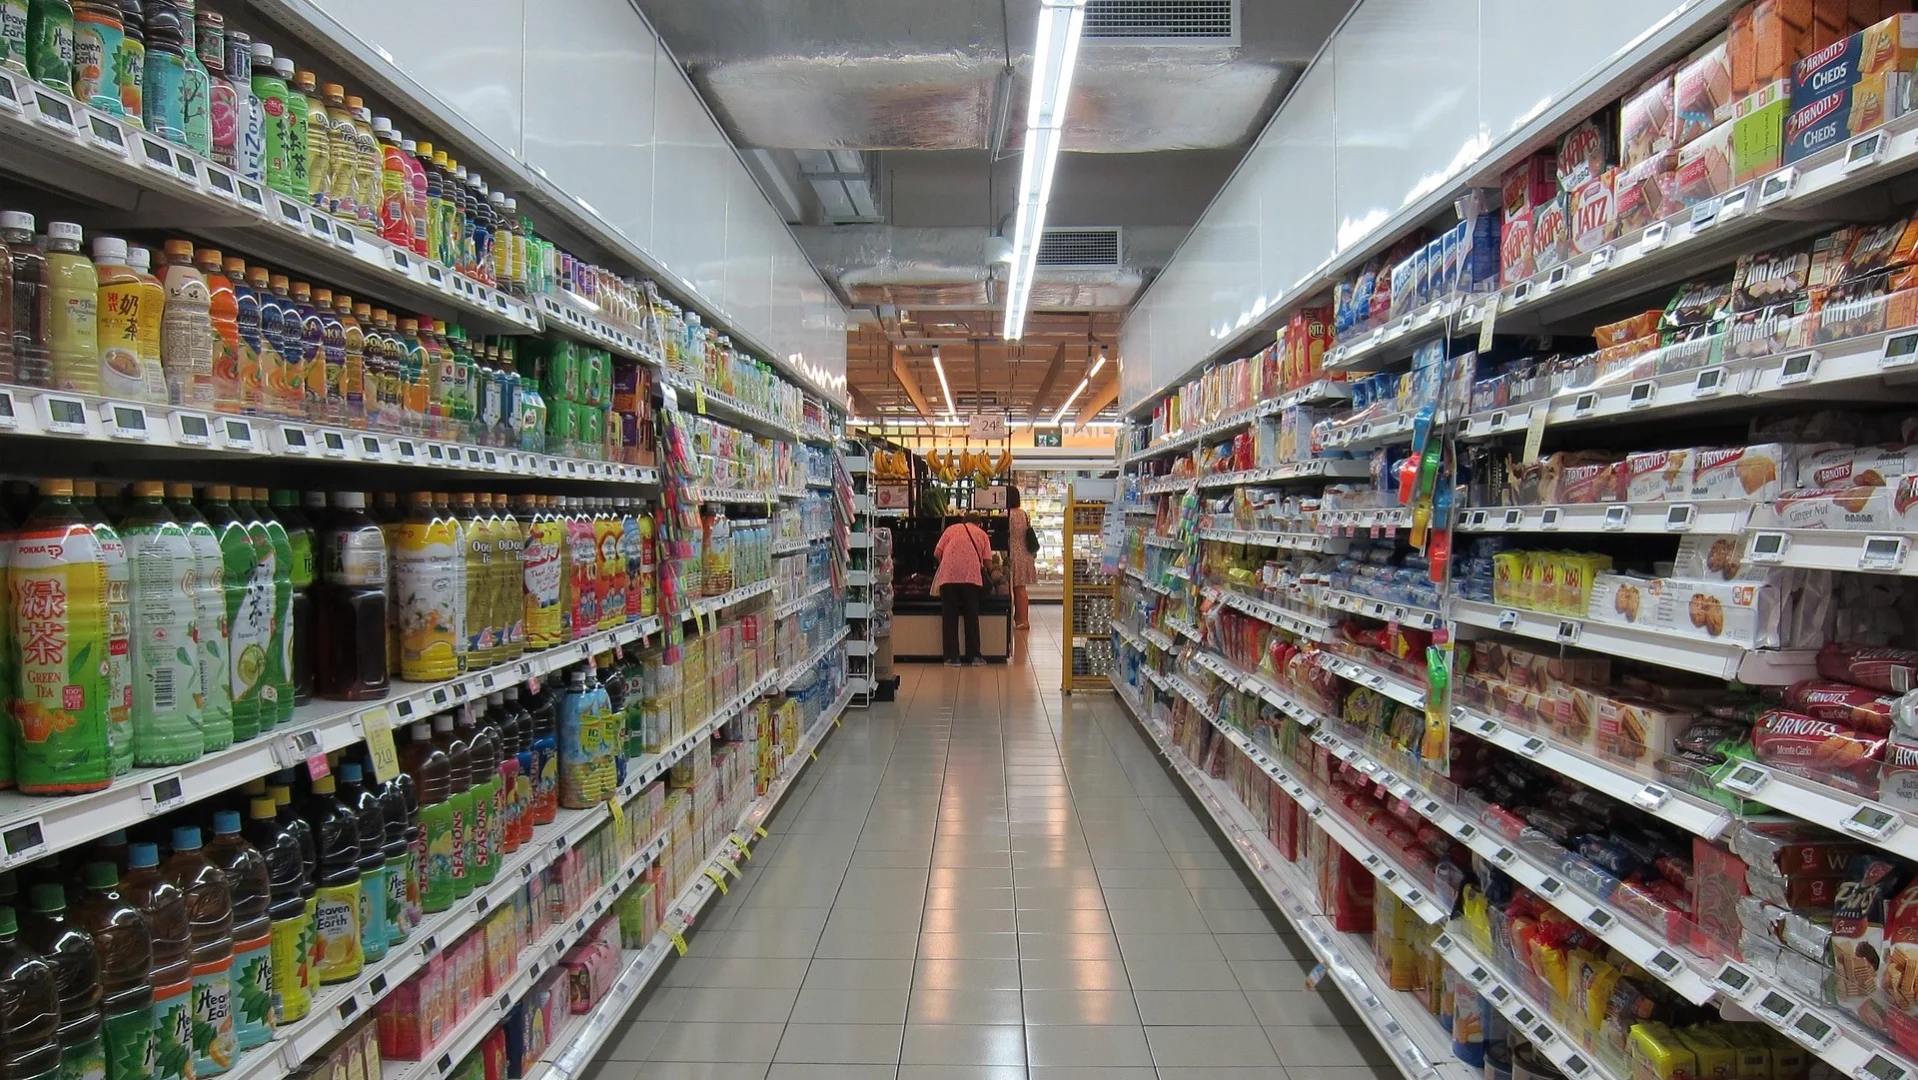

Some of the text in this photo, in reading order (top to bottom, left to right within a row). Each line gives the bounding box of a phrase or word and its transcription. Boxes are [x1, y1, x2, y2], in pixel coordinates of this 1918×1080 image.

[1812, 60, 1848, 90] CHEDS
[1803, 121, 1836, 148] CHEDS
[18, 546, 46, 554] POKKA
[27, 669, 62, 683] GREEN
[35, 685, 54, 698] TEA
[1776, 744, 1812, 756] Monte Carlo
[475, 800, 489, 867] SEASONS
[451, 809, 465, 879] SEASONS
[317, 917, 348, 931] Earth
